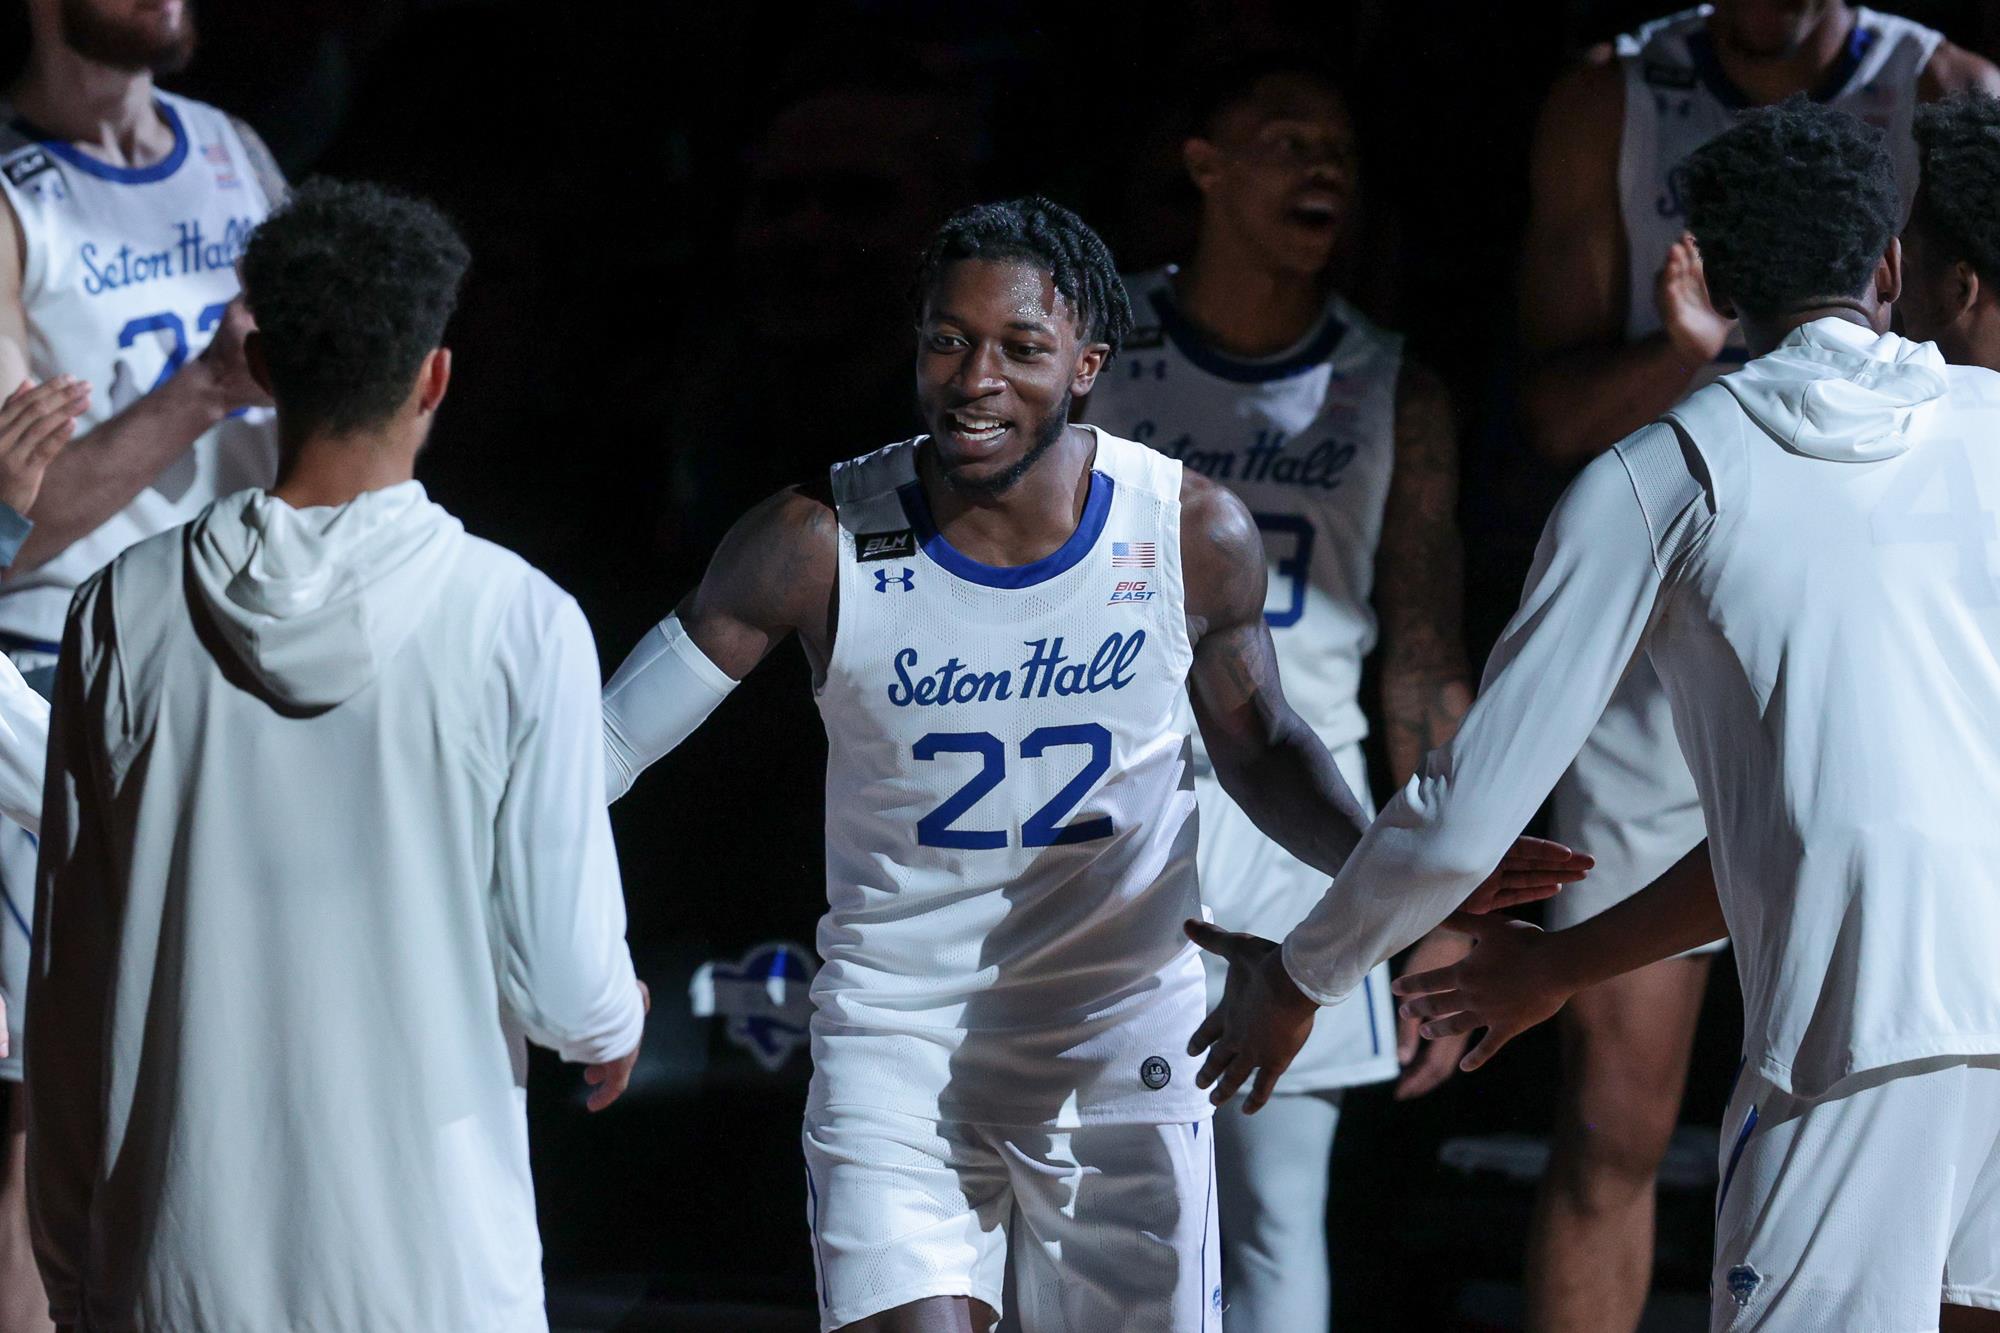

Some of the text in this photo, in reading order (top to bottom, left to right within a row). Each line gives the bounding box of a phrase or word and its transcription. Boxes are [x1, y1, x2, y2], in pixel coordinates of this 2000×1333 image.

[81, 243, 171, 295] Seton
[1240, 430, 1357, 490] Hall
[864, 533, 909, 551] BLM
[1110, 591, 1156, 601] EAST
[1115, 581, 1148, 592] BIG
[888, 629, 1147, 707] Seton Hall
[911, 722, 1115, 850] 22
